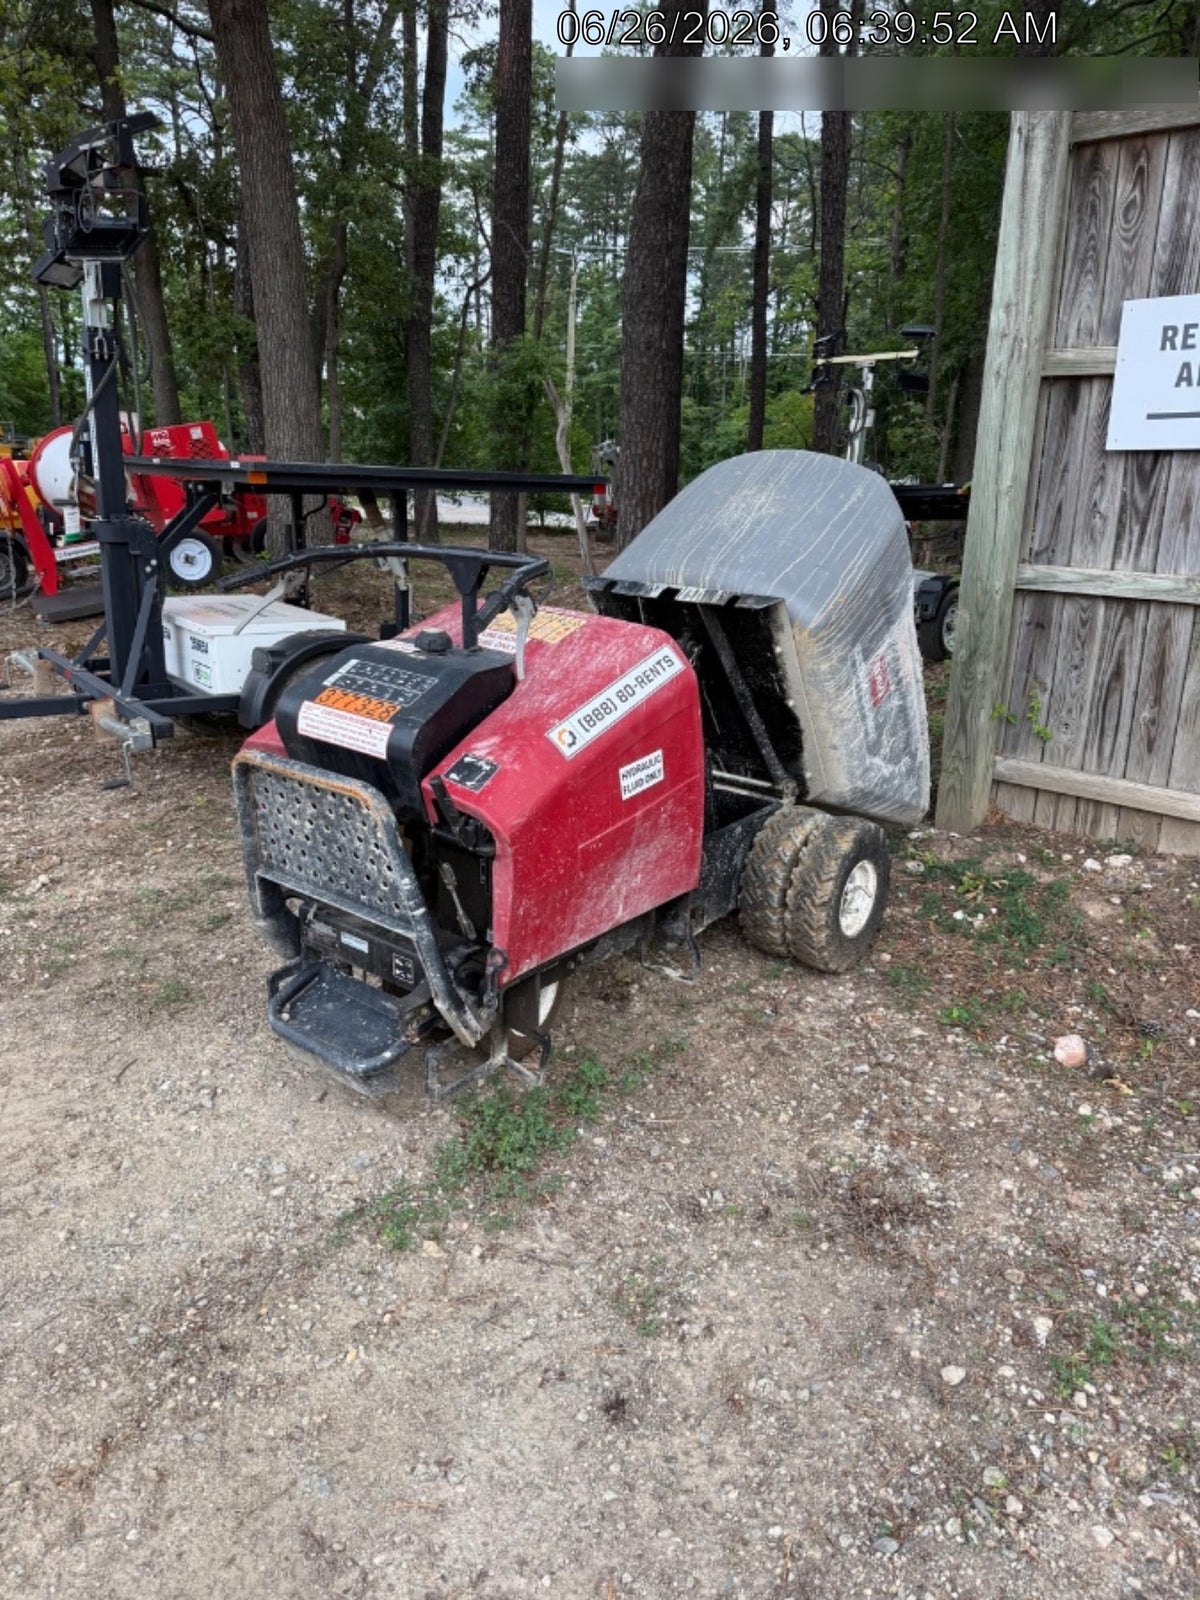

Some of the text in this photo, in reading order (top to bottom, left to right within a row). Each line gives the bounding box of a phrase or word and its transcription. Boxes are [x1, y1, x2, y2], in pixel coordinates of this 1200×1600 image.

[1174, 361, 1200, 388] A
[319, 689, 398, 721] 377328
[577, 655, 675, 733] (888) 80-RENTS
[622, 753, 662, 781] HYDRAULIC
[623, 768, 662, 796] FLUID ONLY
